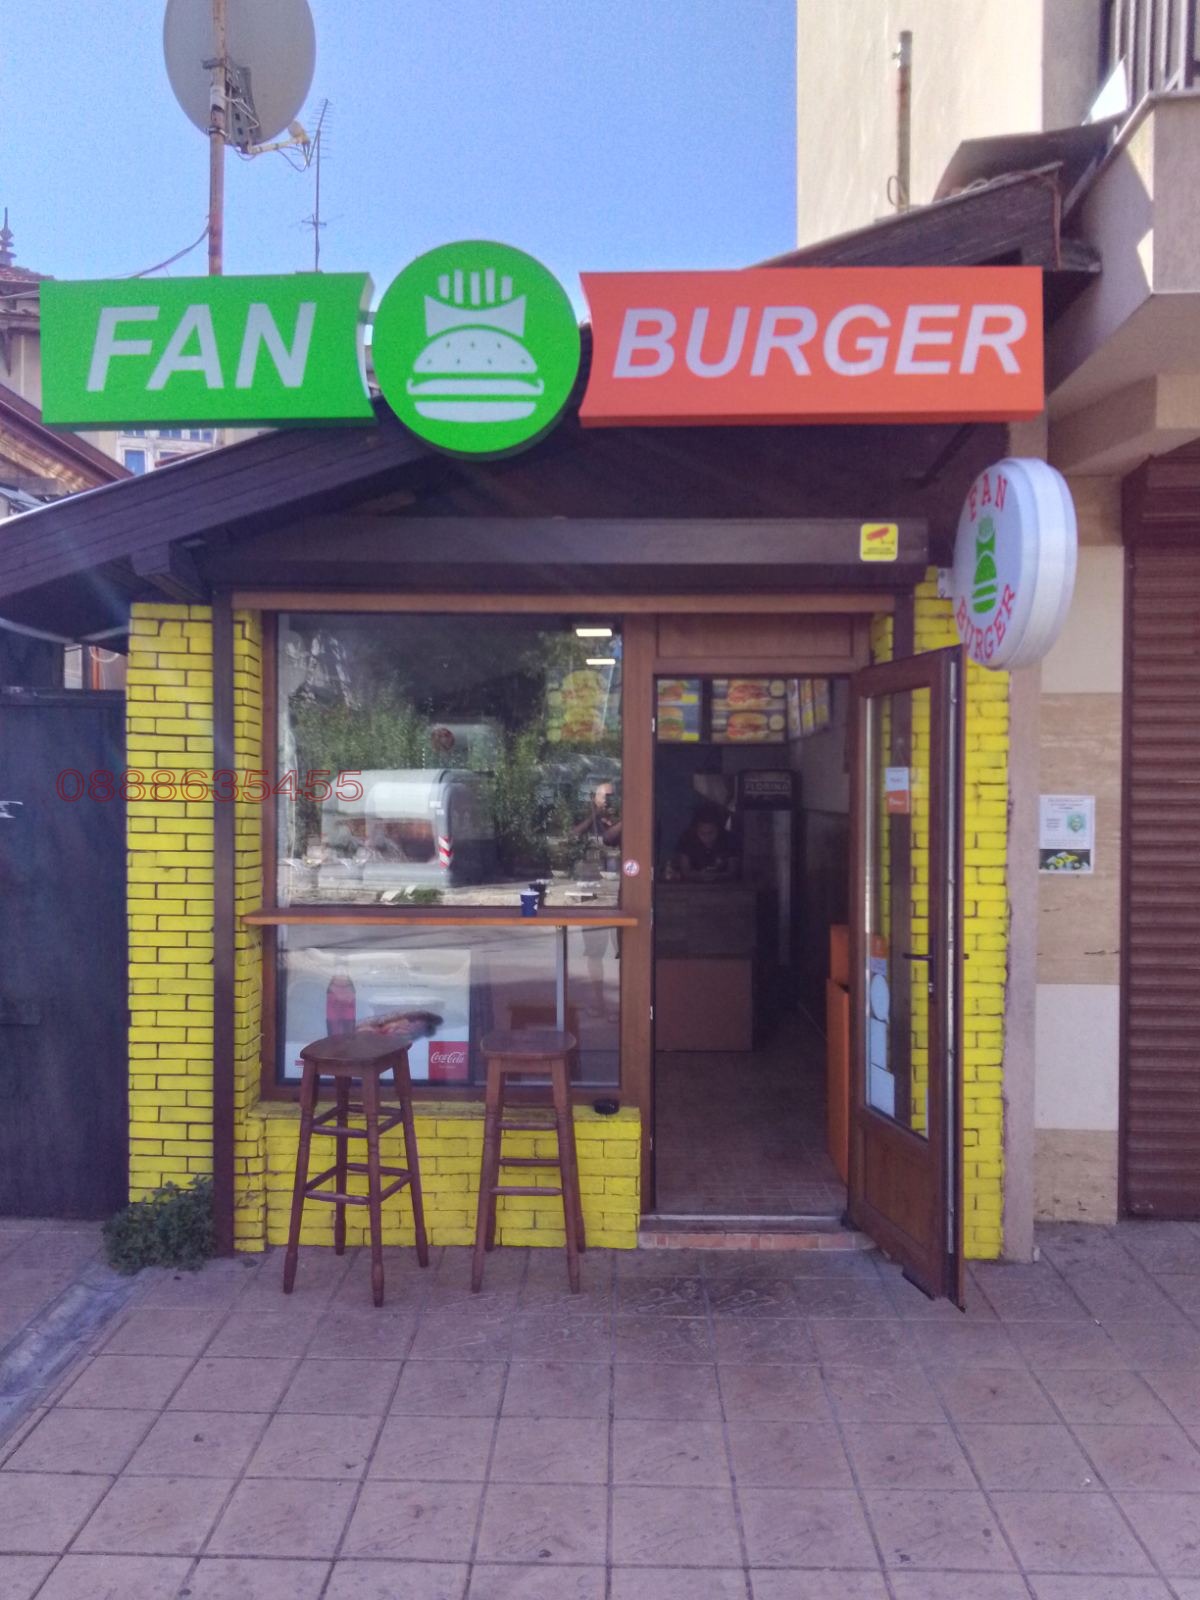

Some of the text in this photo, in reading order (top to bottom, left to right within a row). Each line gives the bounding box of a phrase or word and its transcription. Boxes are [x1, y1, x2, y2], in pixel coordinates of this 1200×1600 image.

[88, 303, 1028, 392] FAN BURGER
[968, 473, 1008, 521] FAN
[957, 584, 1015, 659] BURGER
